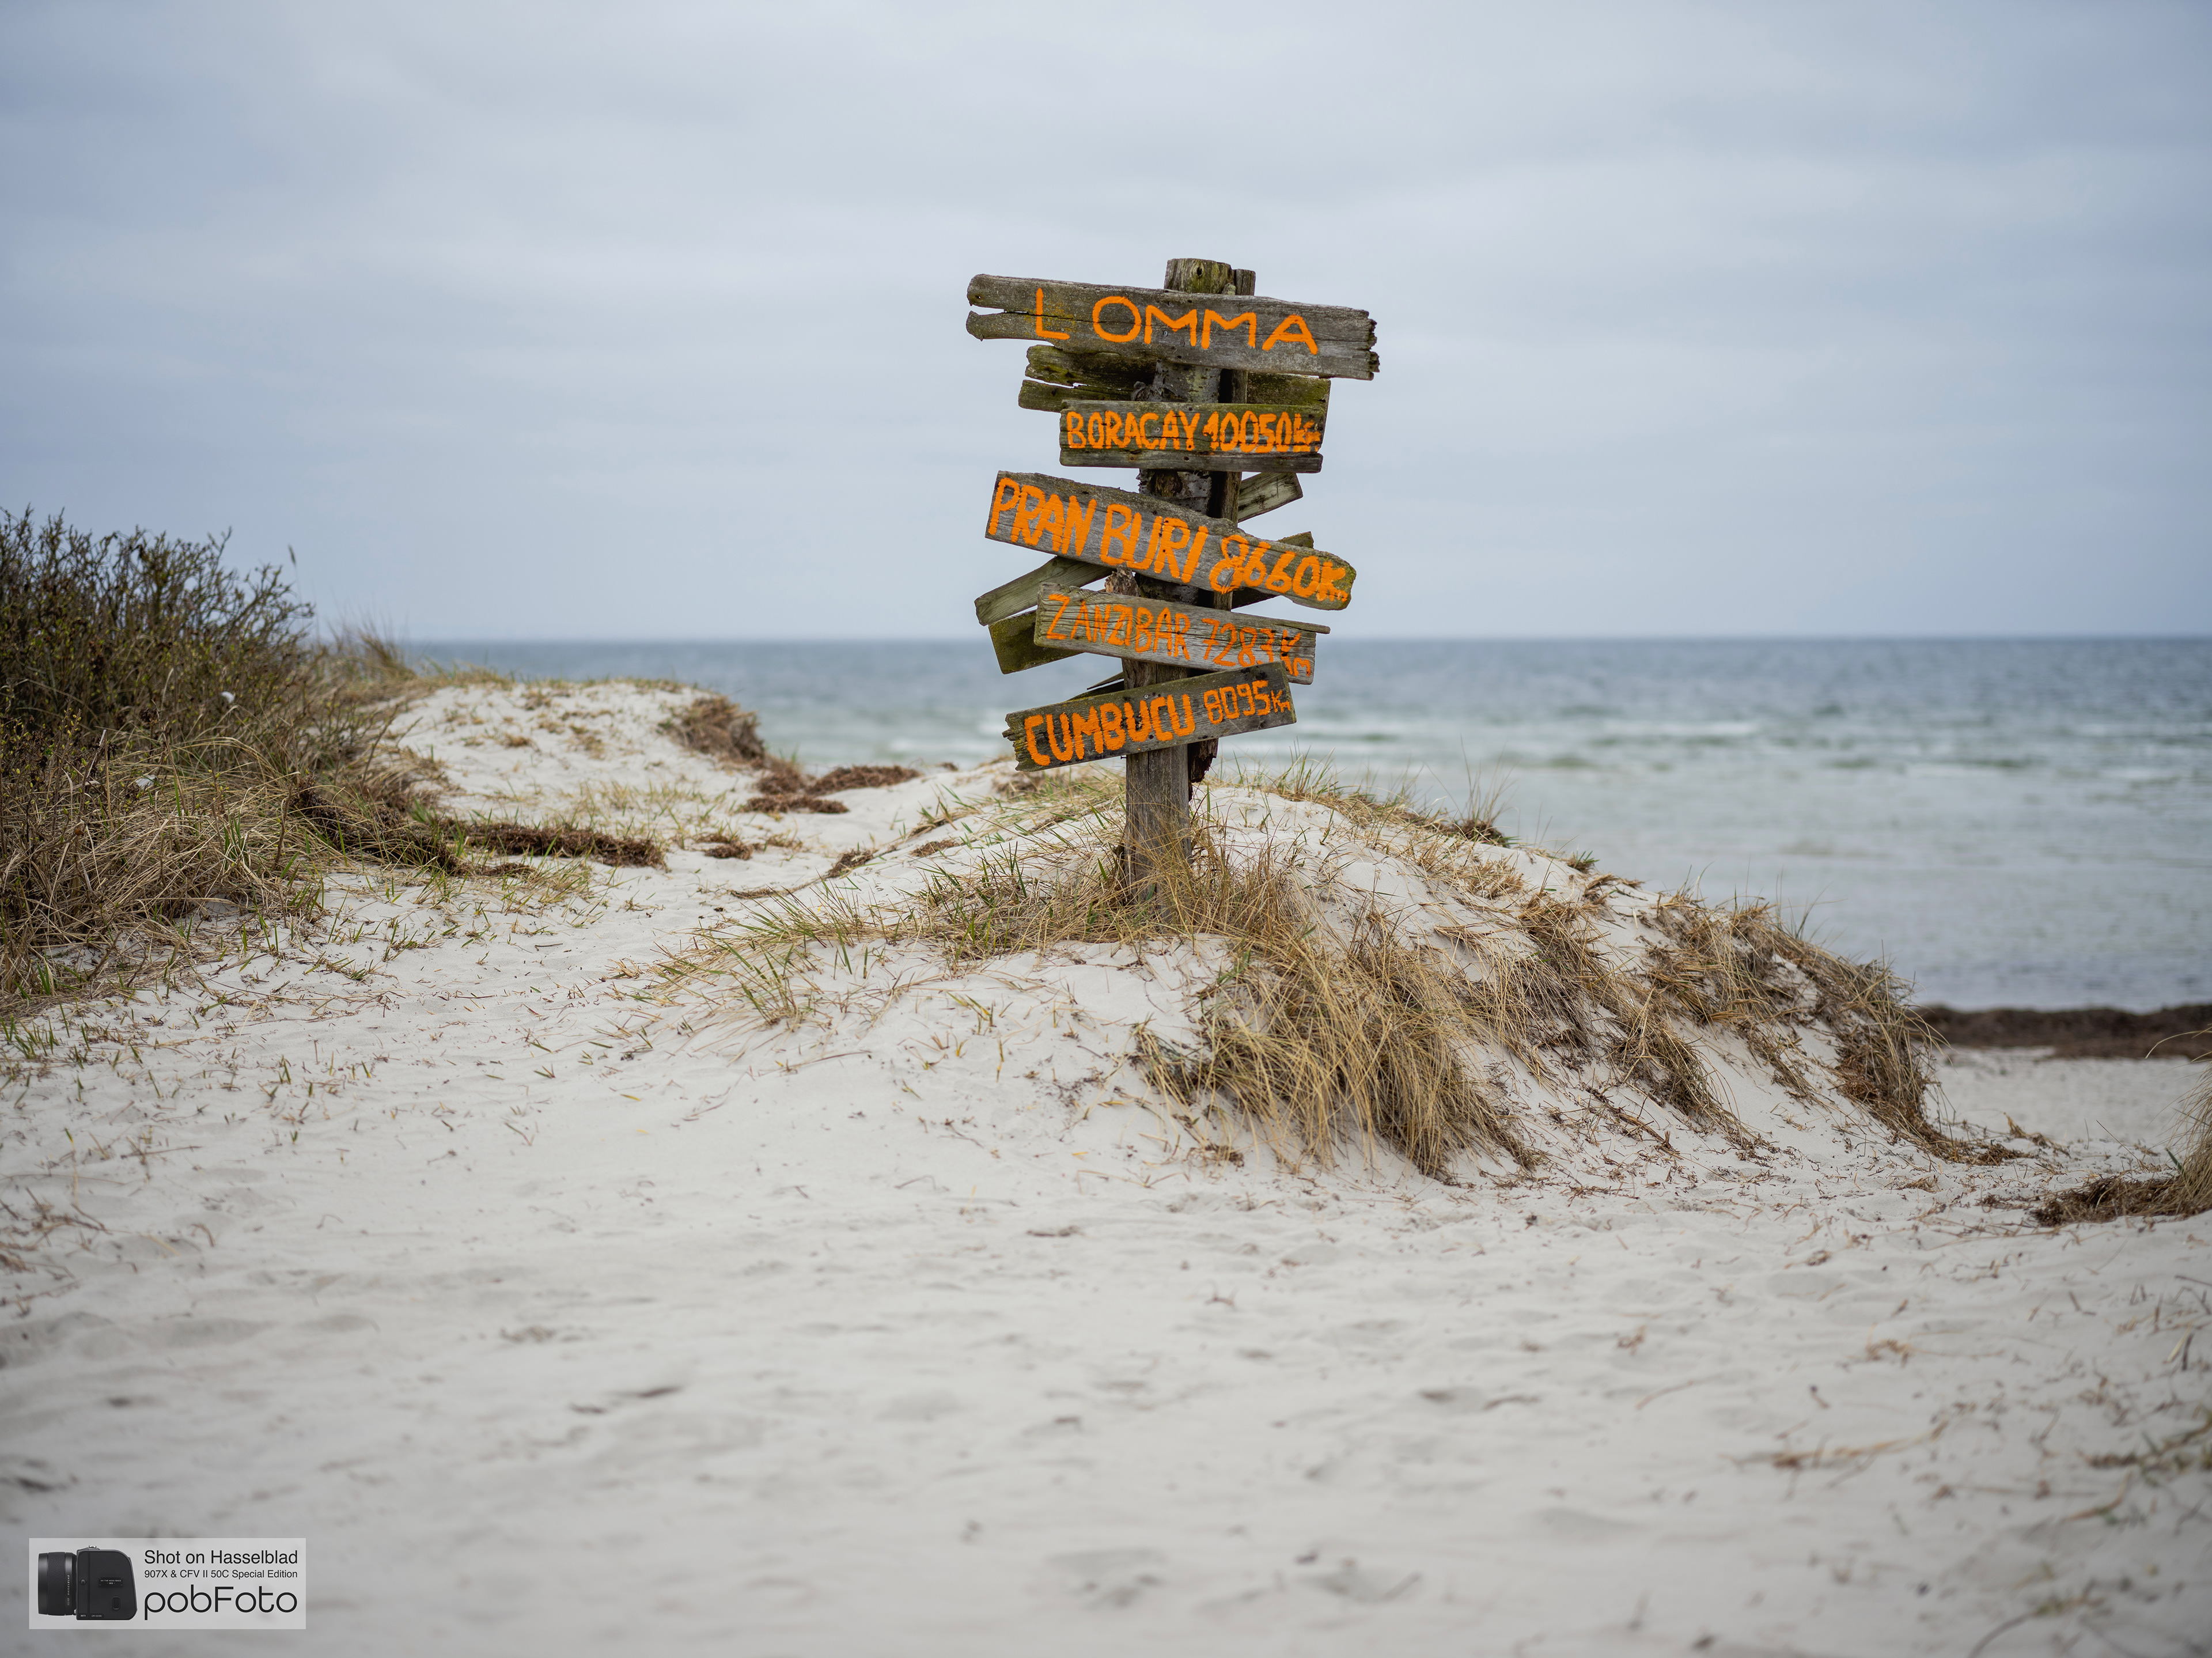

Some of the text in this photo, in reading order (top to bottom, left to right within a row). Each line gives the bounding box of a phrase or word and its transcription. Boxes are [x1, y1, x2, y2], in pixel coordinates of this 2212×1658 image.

[1066, 410, 1200, 451] BORACAY
[988, 477, 1097, 556] PRAN
[1100, 503, 1209, 583] BURI
[1047, 594, 1191, 660] ZANZIBAR
[1024, 694, 1196, 766] CUMBUCU
